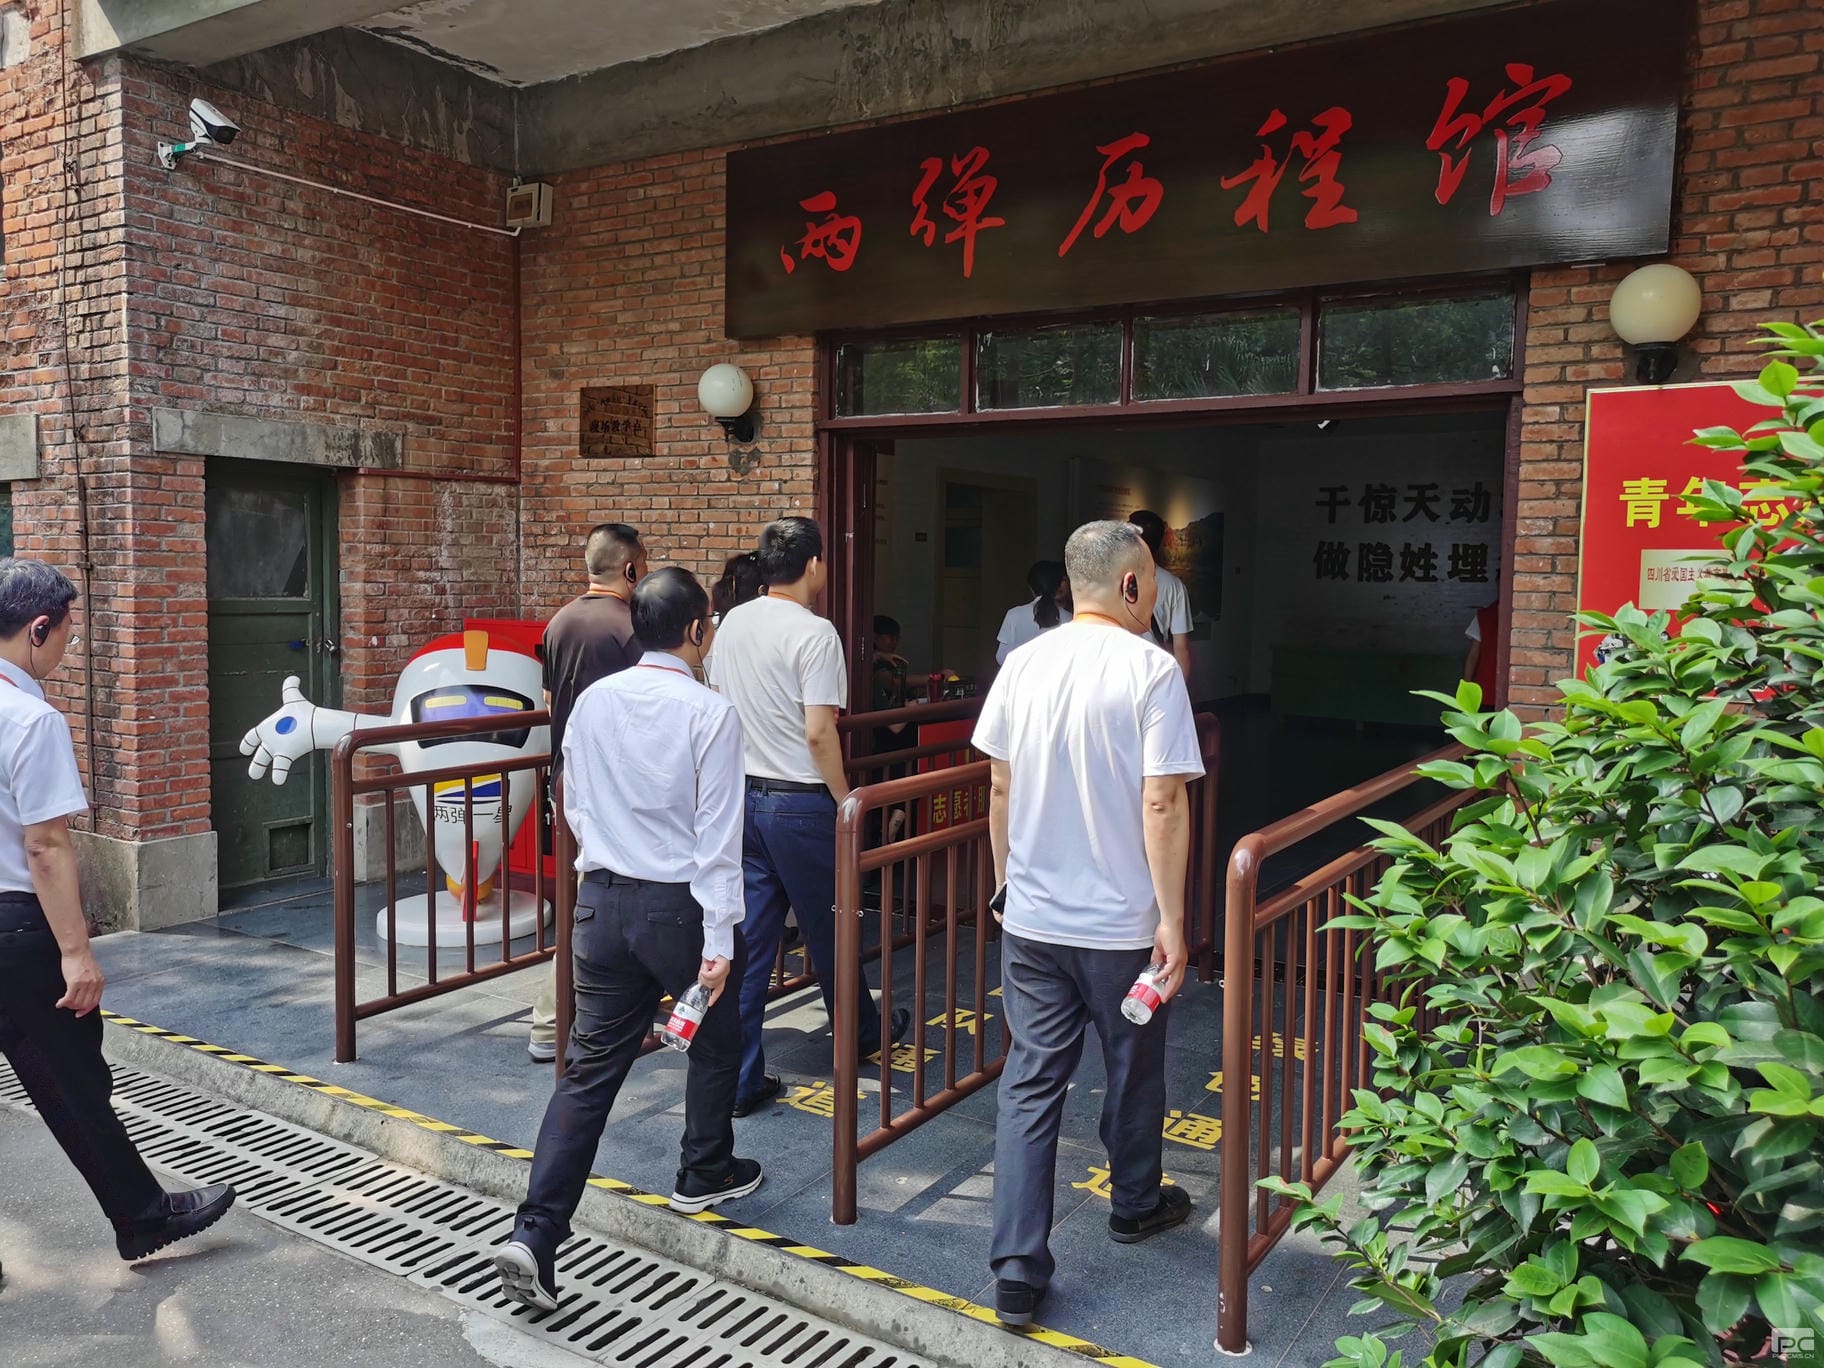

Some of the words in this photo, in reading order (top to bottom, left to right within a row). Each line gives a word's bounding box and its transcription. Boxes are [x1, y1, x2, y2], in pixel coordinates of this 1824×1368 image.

[779, 62, 1574, 279] 两弹历程馆
[1315, 481, 1503, 524] 干惊天动
[1619, 475, 1824, 530] 青年志
[1312, 541, 1501, 583] 做隐姓埋
